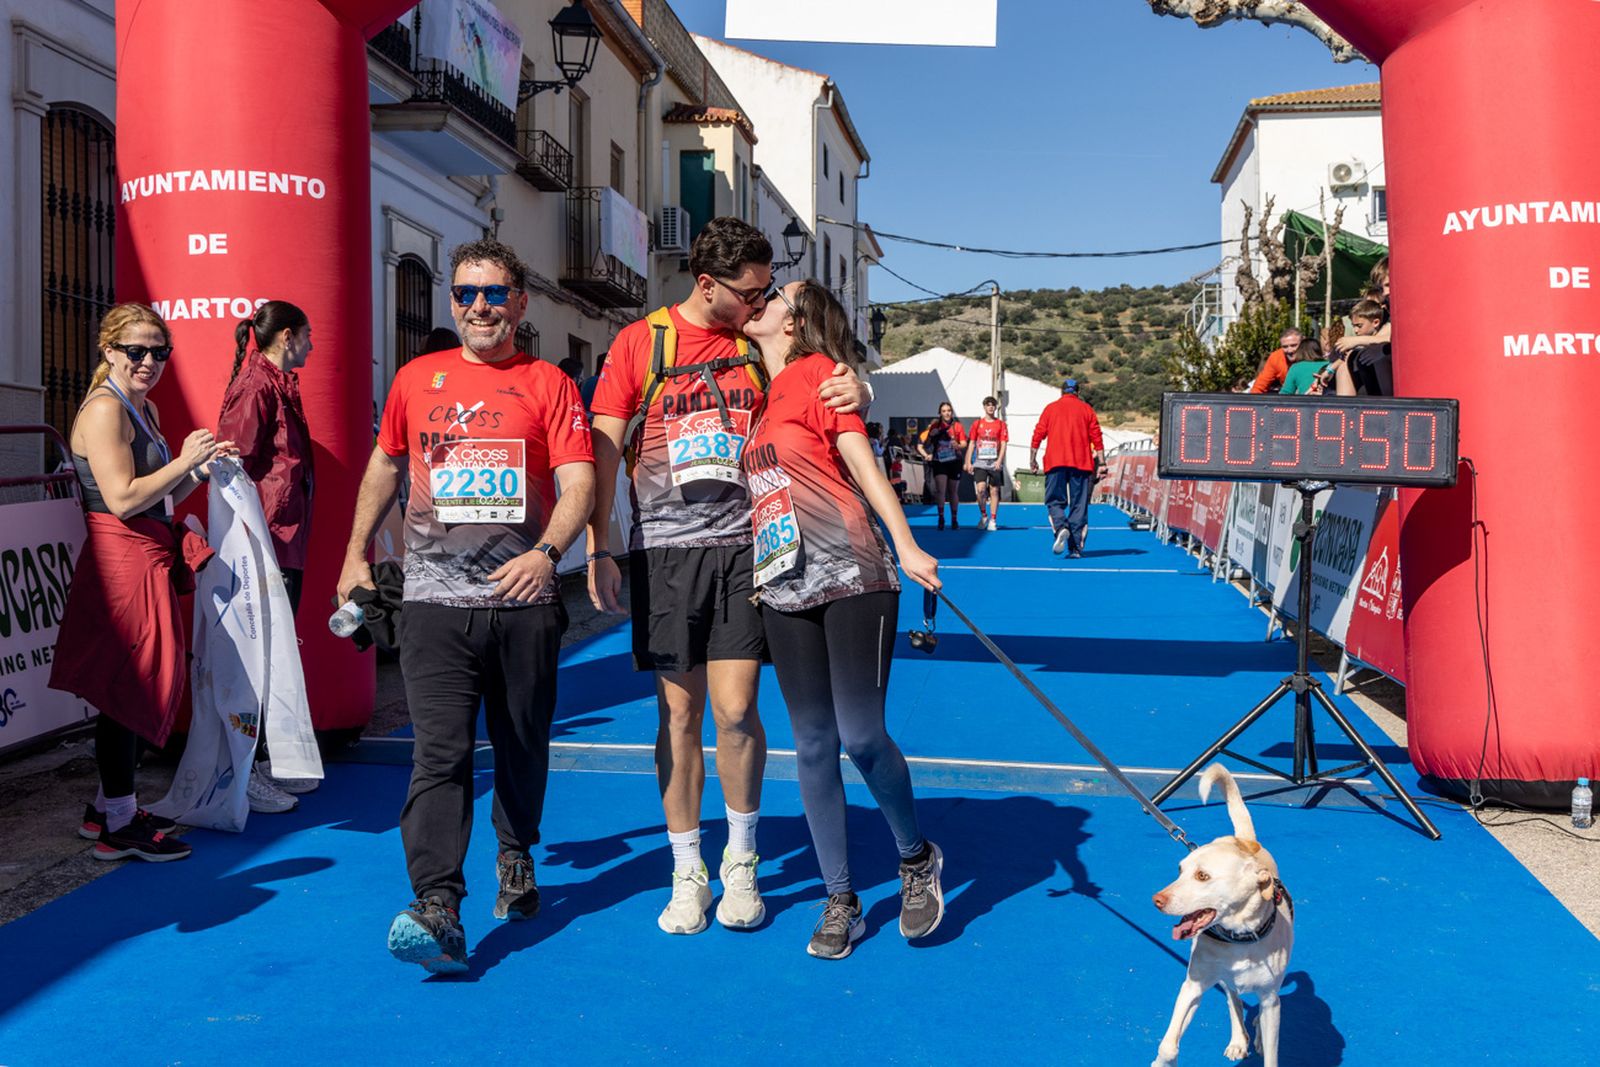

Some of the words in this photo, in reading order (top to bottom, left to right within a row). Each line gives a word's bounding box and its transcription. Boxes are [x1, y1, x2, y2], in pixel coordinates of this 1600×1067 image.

[121, 169, 326, 204] AYUNTAMIENTO
[188, 233, 228, 255] DE
[1549, 267, 1590, 288] DE
[428, 405, 504, 428] CROSS
[445, 446, 459, 461] X
[461, 449, 509, 461] CROSS
[674, 432, 745, 465] 2387
[435, 469, 519, 498] 2230
[756, 514, 795, 563] 2385
[241, 555, 251, 590] Deportes
